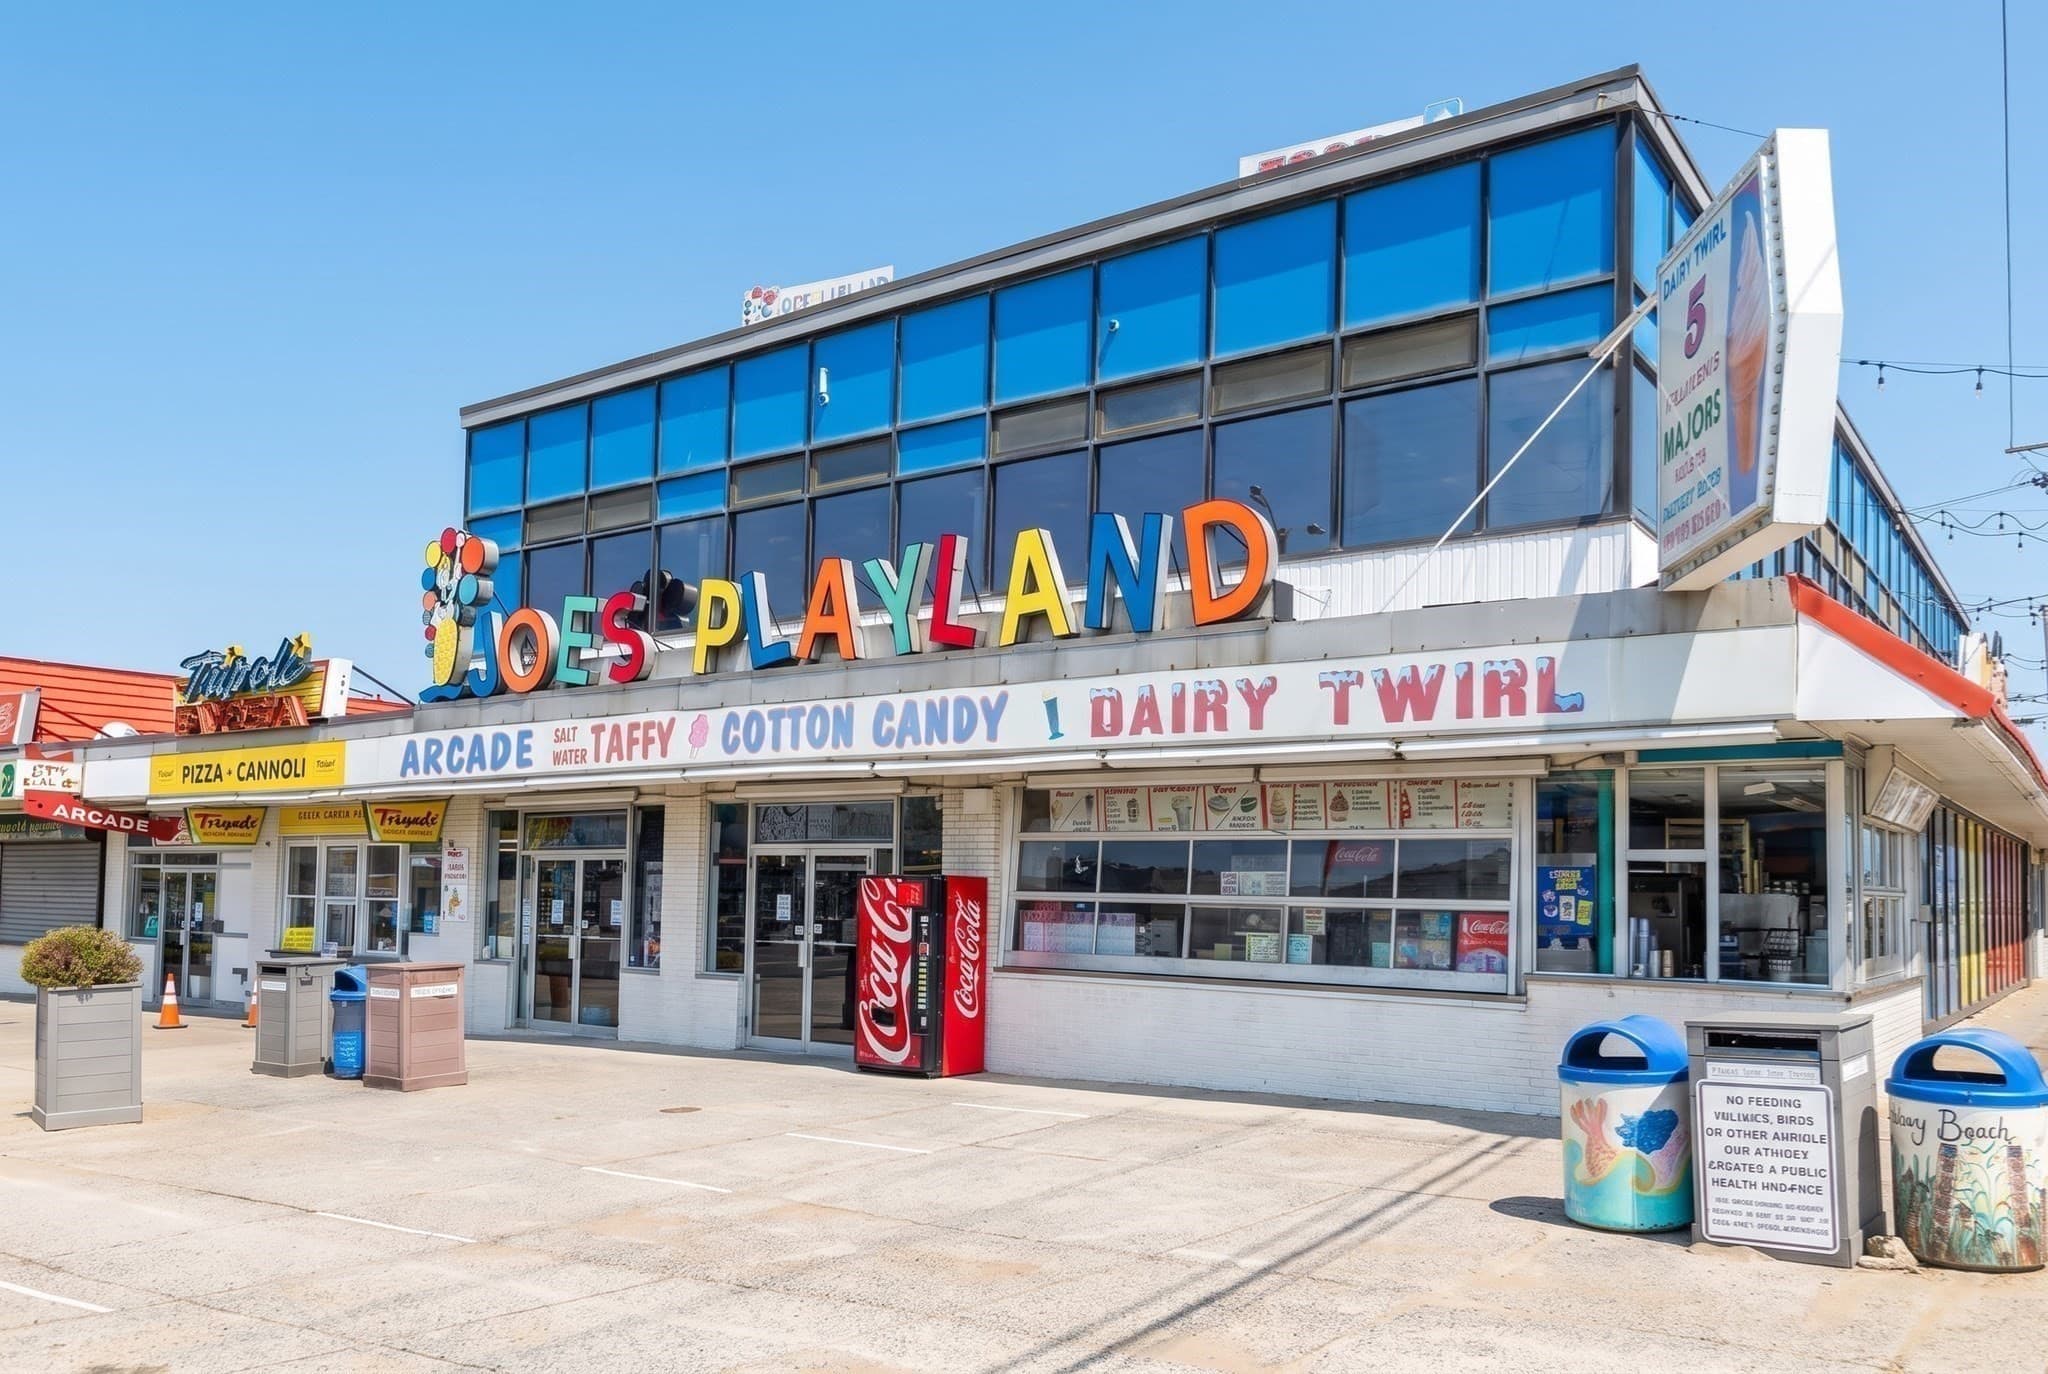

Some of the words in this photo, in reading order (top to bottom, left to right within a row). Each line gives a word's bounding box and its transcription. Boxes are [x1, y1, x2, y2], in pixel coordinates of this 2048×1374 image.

[1663, 254, 1692, 301] DAIRY
[1694, 217, 1727, 267] TWIRL
[1664, 388, 1721, 466] MAJORS
[692, 499, 1278, 675] PLAYLAND
[1088, 675, 1278, 739] DAIRY
[1318, 656, 1585, 726] TWIRL
[553, 726, 579, 744] SALT
[720, 700, 856, 756] COTTON
[871, 690, 1010, 750] CANDY
[399, 728, 534, 779] ARCADE
[590, 716, 677, 764] TAFFY
[182, 763, 224, 785] PIZZA
[236, 757, 306, 783] CANNOLI
[552, 747, 588, 767] WATER
[52, 803, 150, 833] ARCADE
[1726, 1095, 1744, 1106] NO
[1748, 1096, 1803, 1109] FEEDING
[1705, 1127, 1723, 1137] OR
[1726, 1128, 1769, 1141] OTHER
[1776, 1114, 1815, 1126] BIRDS
[1724, 1144, 1751, 1156] OUR
[1711, 1177, 1758, 1190] HEALTH
[1768, 1165, 1777, 1175] A
[1781, 1165, 1828, 1179] PUBLIC
